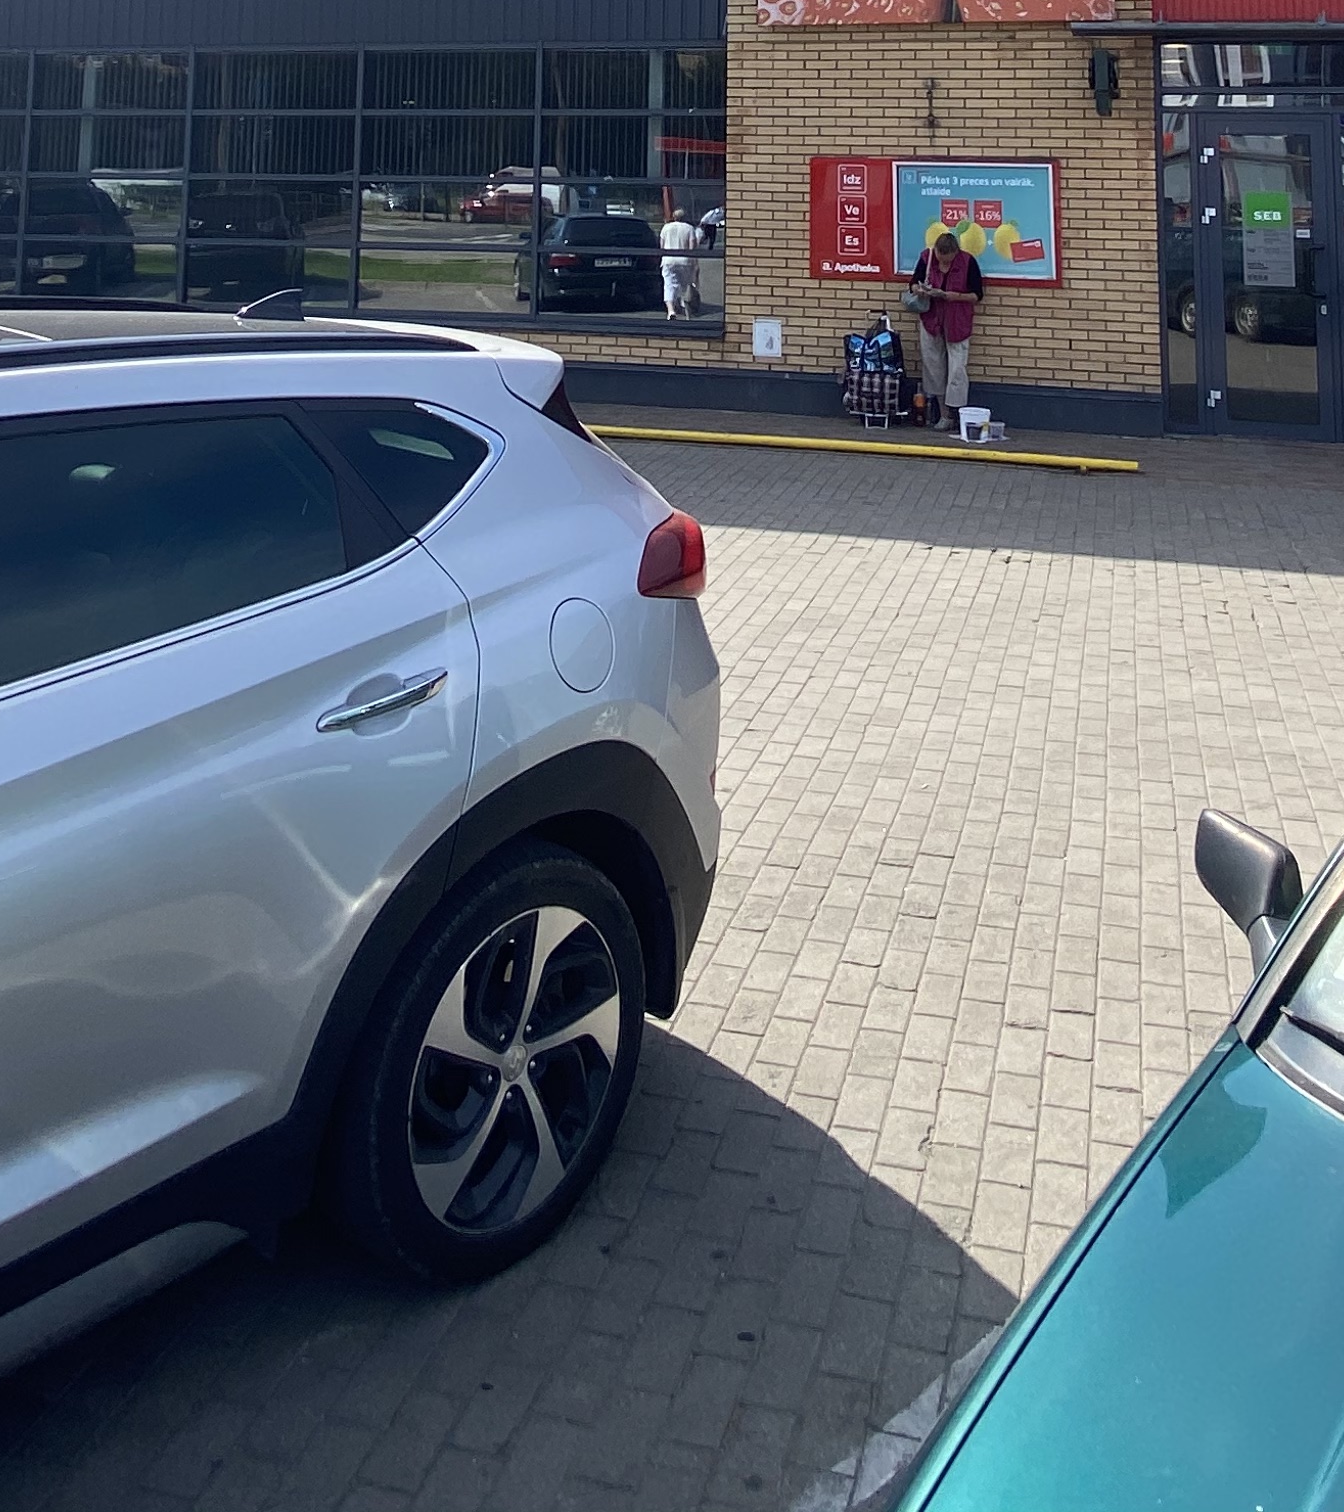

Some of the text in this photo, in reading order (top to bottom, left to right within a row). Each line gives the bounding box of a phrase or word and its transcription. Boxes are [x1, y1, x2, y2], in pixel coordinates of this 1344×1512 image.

[952, 176, 958, 186] 3
[959, 178, 990, 187] preces
[991, 178, 1003, 186] un
[975, 210, 1001, 222] -16%
[1253, 210, 1282, 221] SEB
